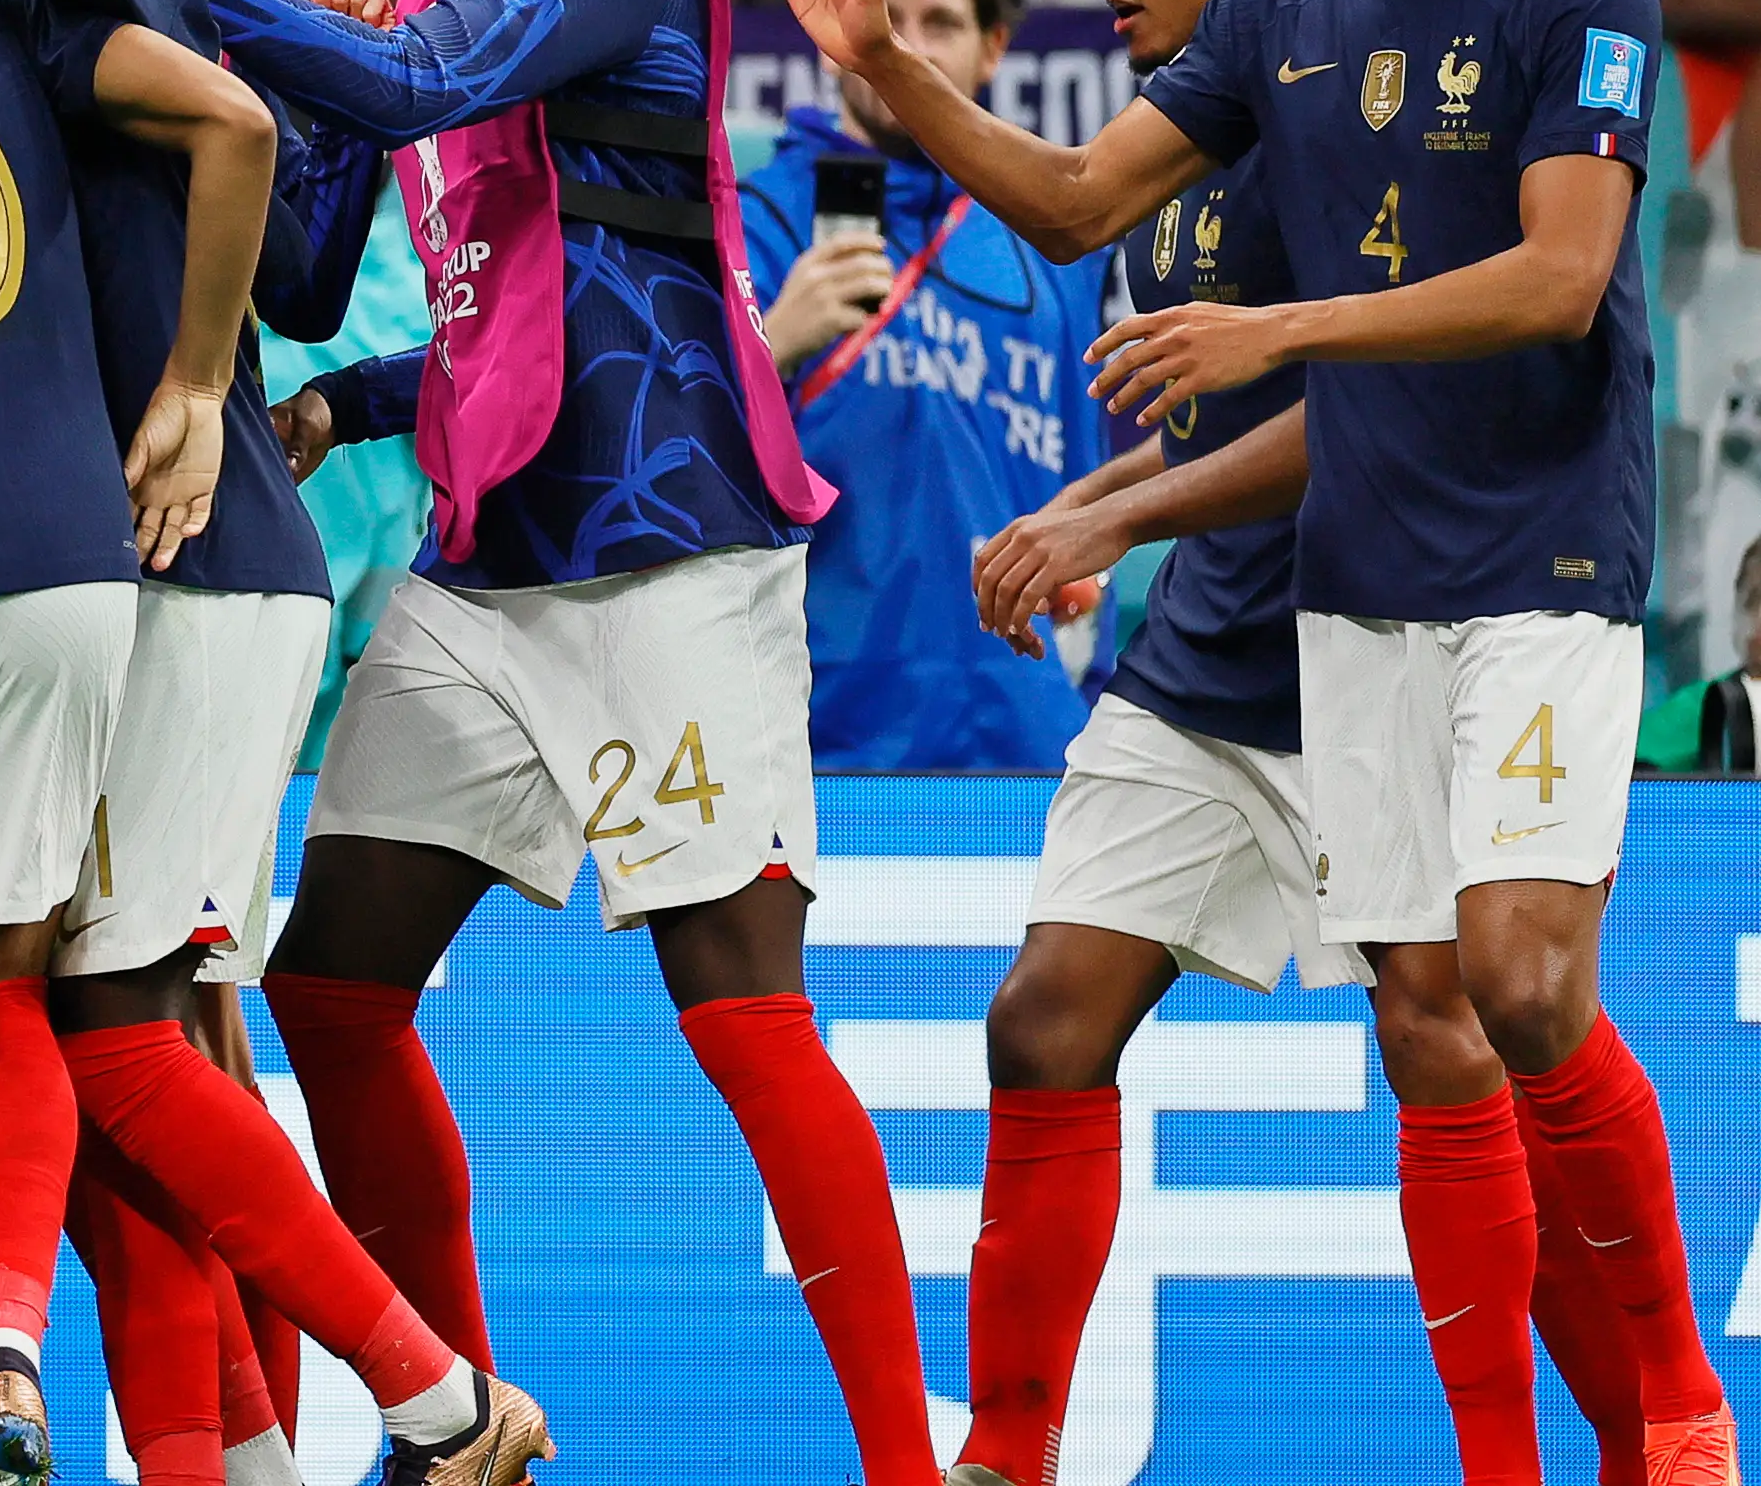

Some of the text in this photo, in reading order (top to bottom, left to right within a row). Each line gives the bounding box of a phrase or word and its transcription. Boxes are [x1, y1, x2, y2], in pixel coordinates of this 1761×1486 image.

[1372, 100, 1391, 110] FIFA
[1467, 140, 1490, 151] 2022
[1359, 181, 1409, 284] 4
[583, 720, 726, 844] 24
[1498, 703, 1568, 806] 4
